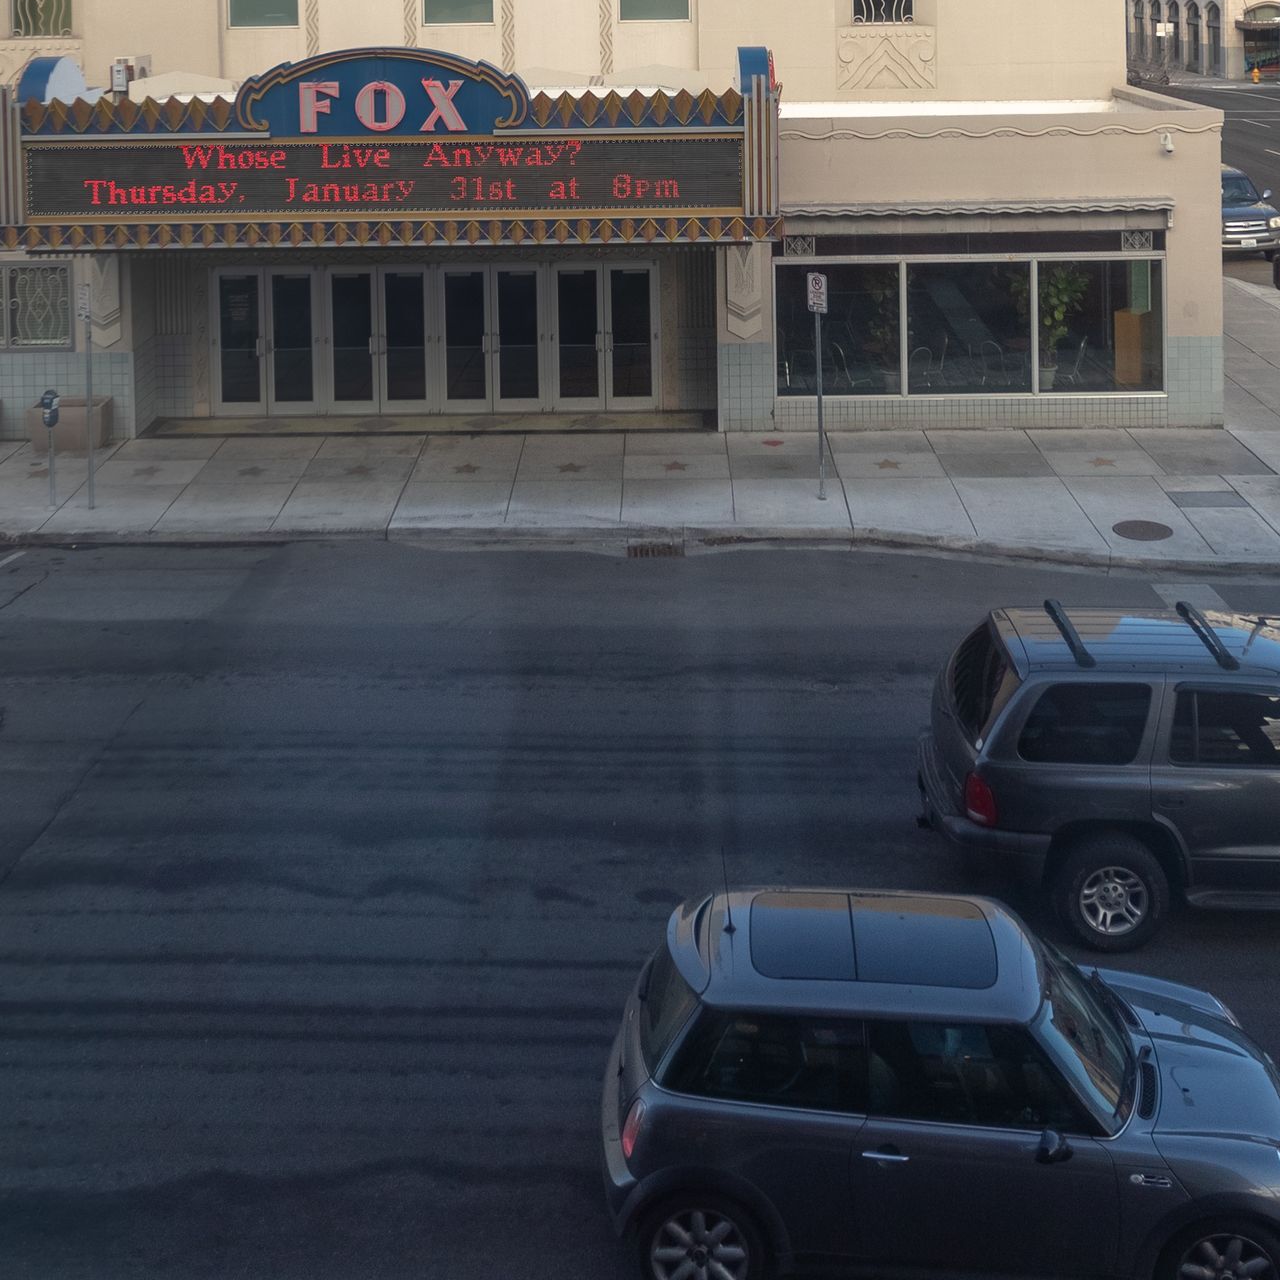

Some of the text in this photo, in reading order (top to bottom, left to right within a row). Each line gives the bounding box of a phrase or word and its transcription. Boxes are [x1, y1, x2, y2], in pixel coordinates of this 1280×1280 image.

[299, 78, 468, 133] FOX
[179, 140, 581, 170] Whose Live Anyway?
[83, 174, 680, 205] Thursday, January 31st at 8pm
